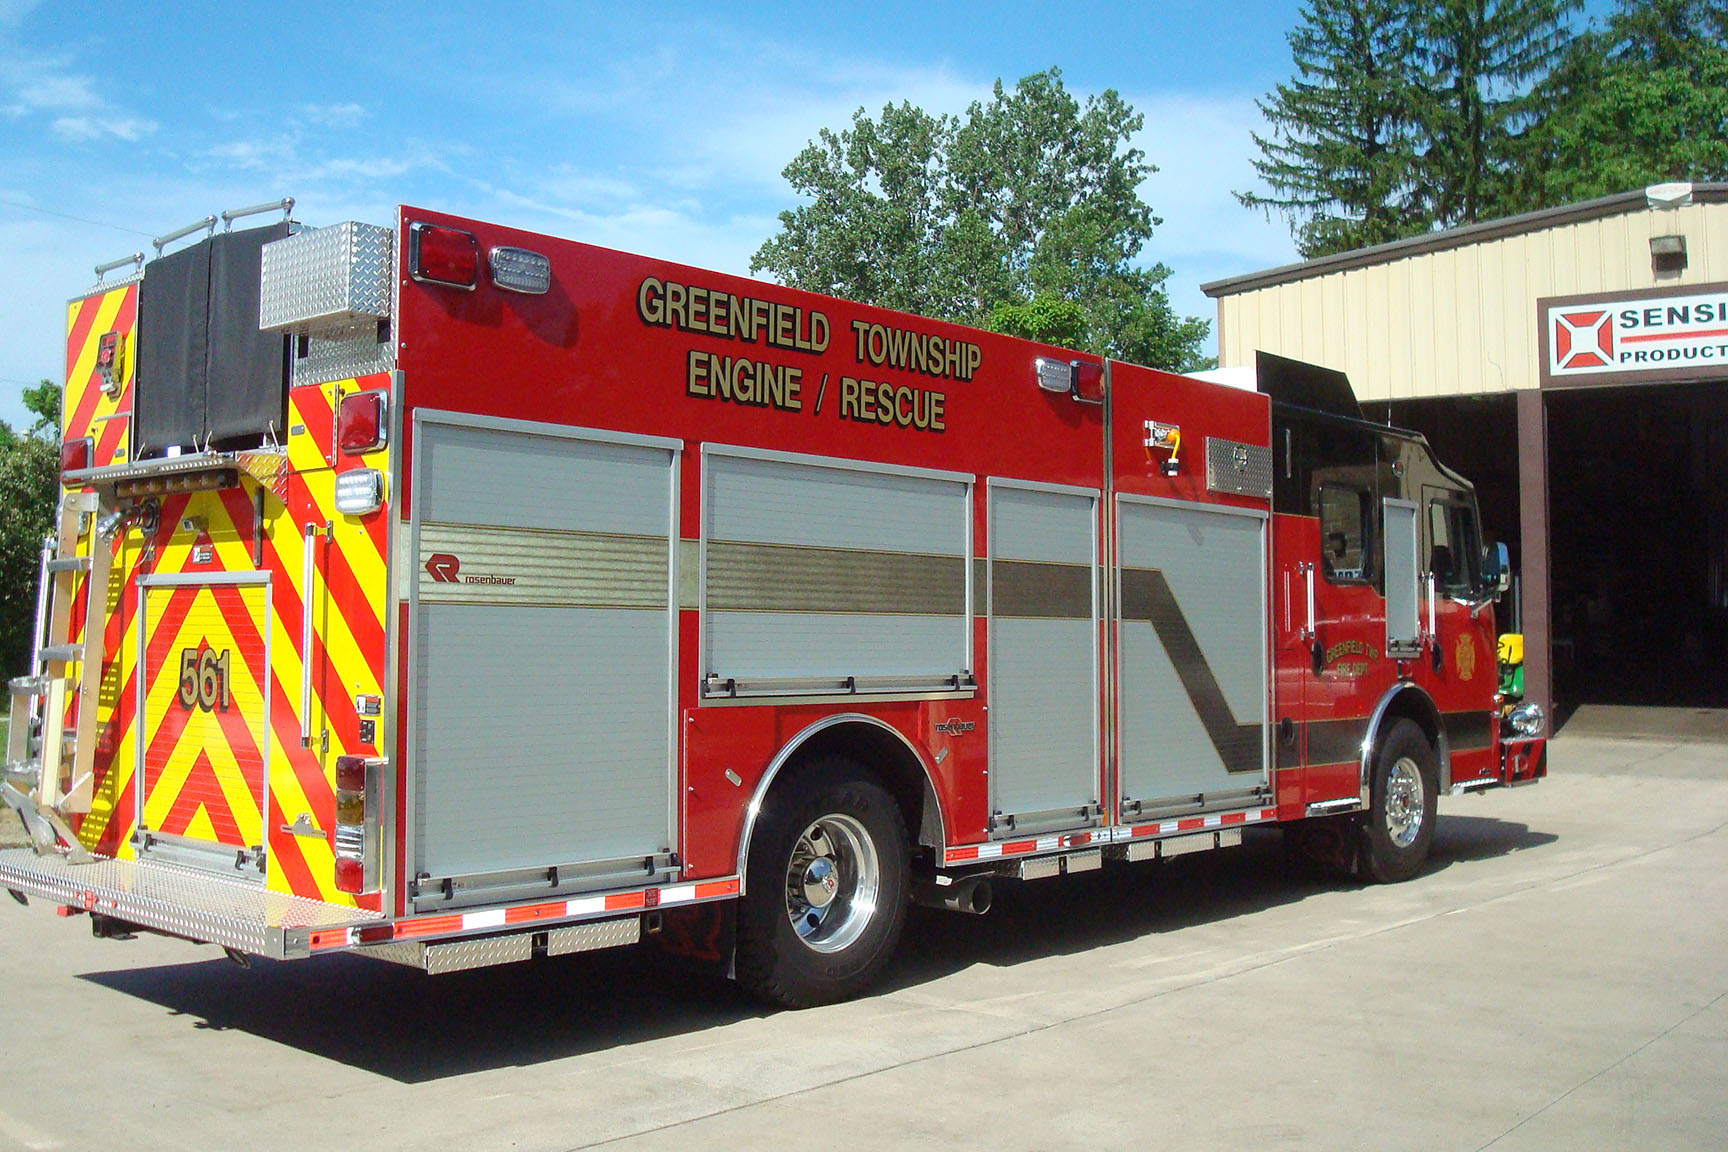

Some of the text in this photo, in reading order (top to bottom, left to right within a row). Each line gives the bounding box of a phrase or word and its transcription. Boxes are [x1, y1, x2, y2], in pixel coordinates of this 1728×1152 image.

[638, 276, 982, 382] GREENFIELD TOWNSHIP
[1620, 302, 1727, 328] SENSI
[1619, 344, 1728, 364] PRODUCT
[687, 349, 802, 413] ENGINE
[839, 376, 946, 432] RESCUE
[465, 574, 516, 585] rosenbauer
[179, 647, 230, 713] 561
